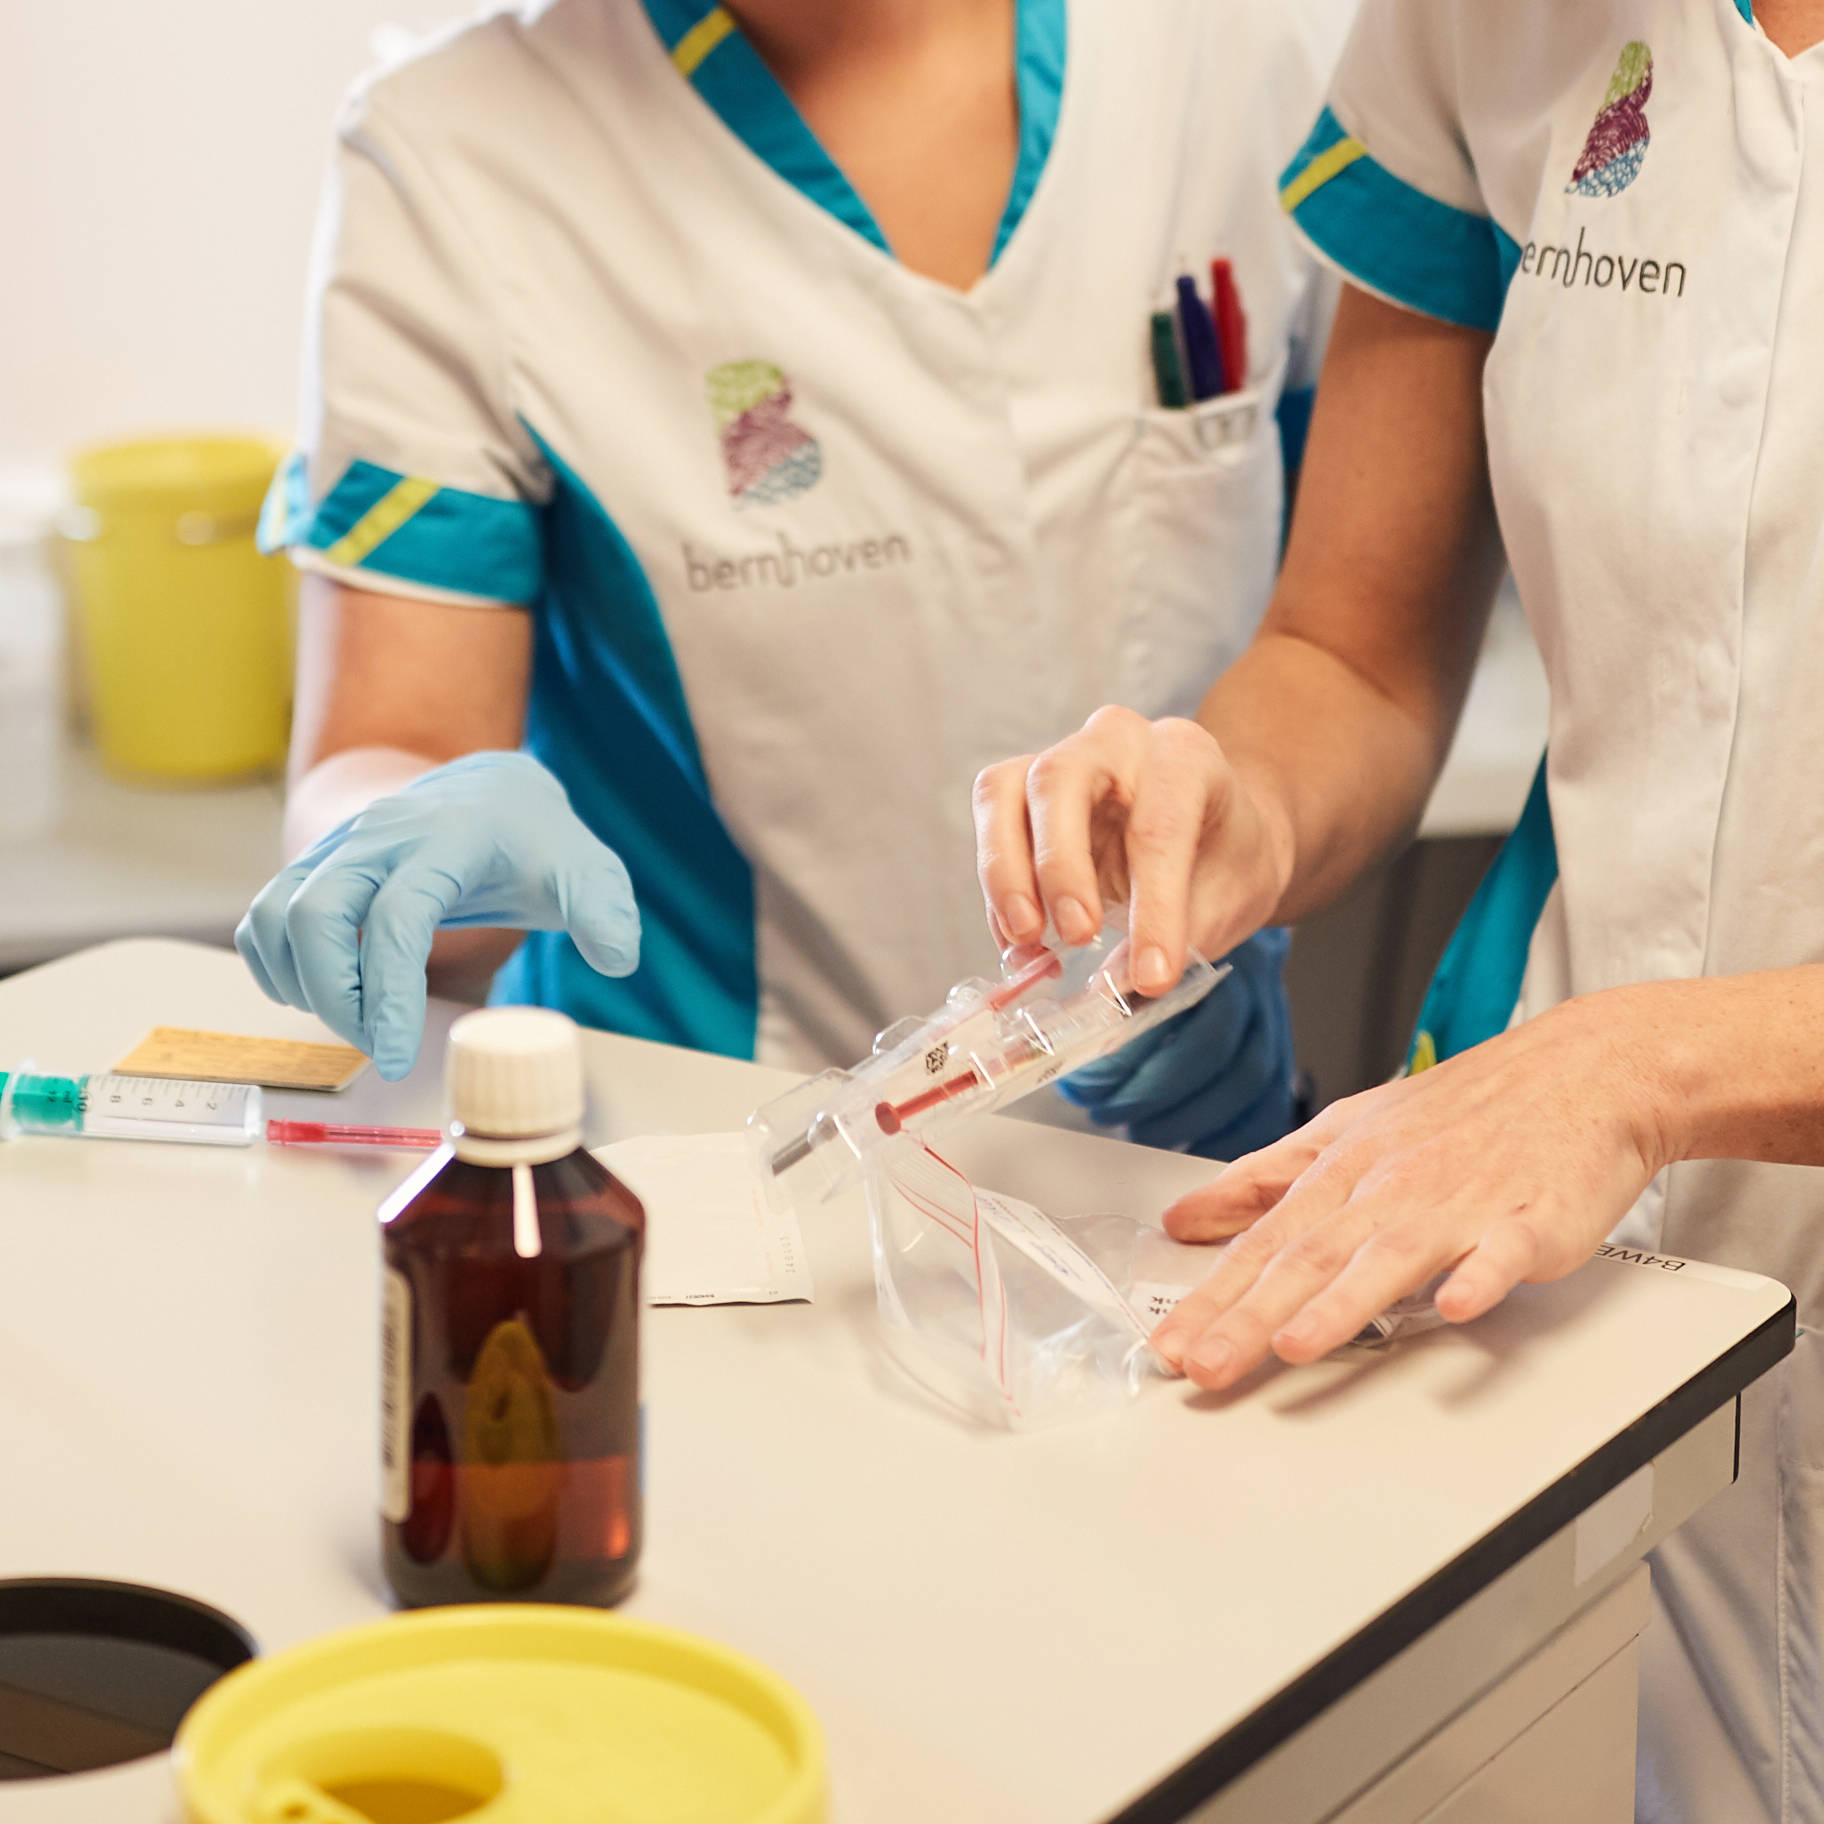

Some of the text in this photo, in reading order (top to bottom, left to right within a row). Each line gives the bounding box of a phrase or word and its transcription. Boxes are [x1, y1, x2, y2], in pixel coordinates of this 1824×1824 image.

[1521, 226, 1686, 297] ernhoven
[680, 531, 912, 593] bernhoven
[78, 1093, 88, 1112] 10
[111, 1094, 121, 1104] 8
[142, 1097, 153, 1106] 6
[175, 1099, 185, 1108] 4
[207, 1102, 217, 1110] 2
